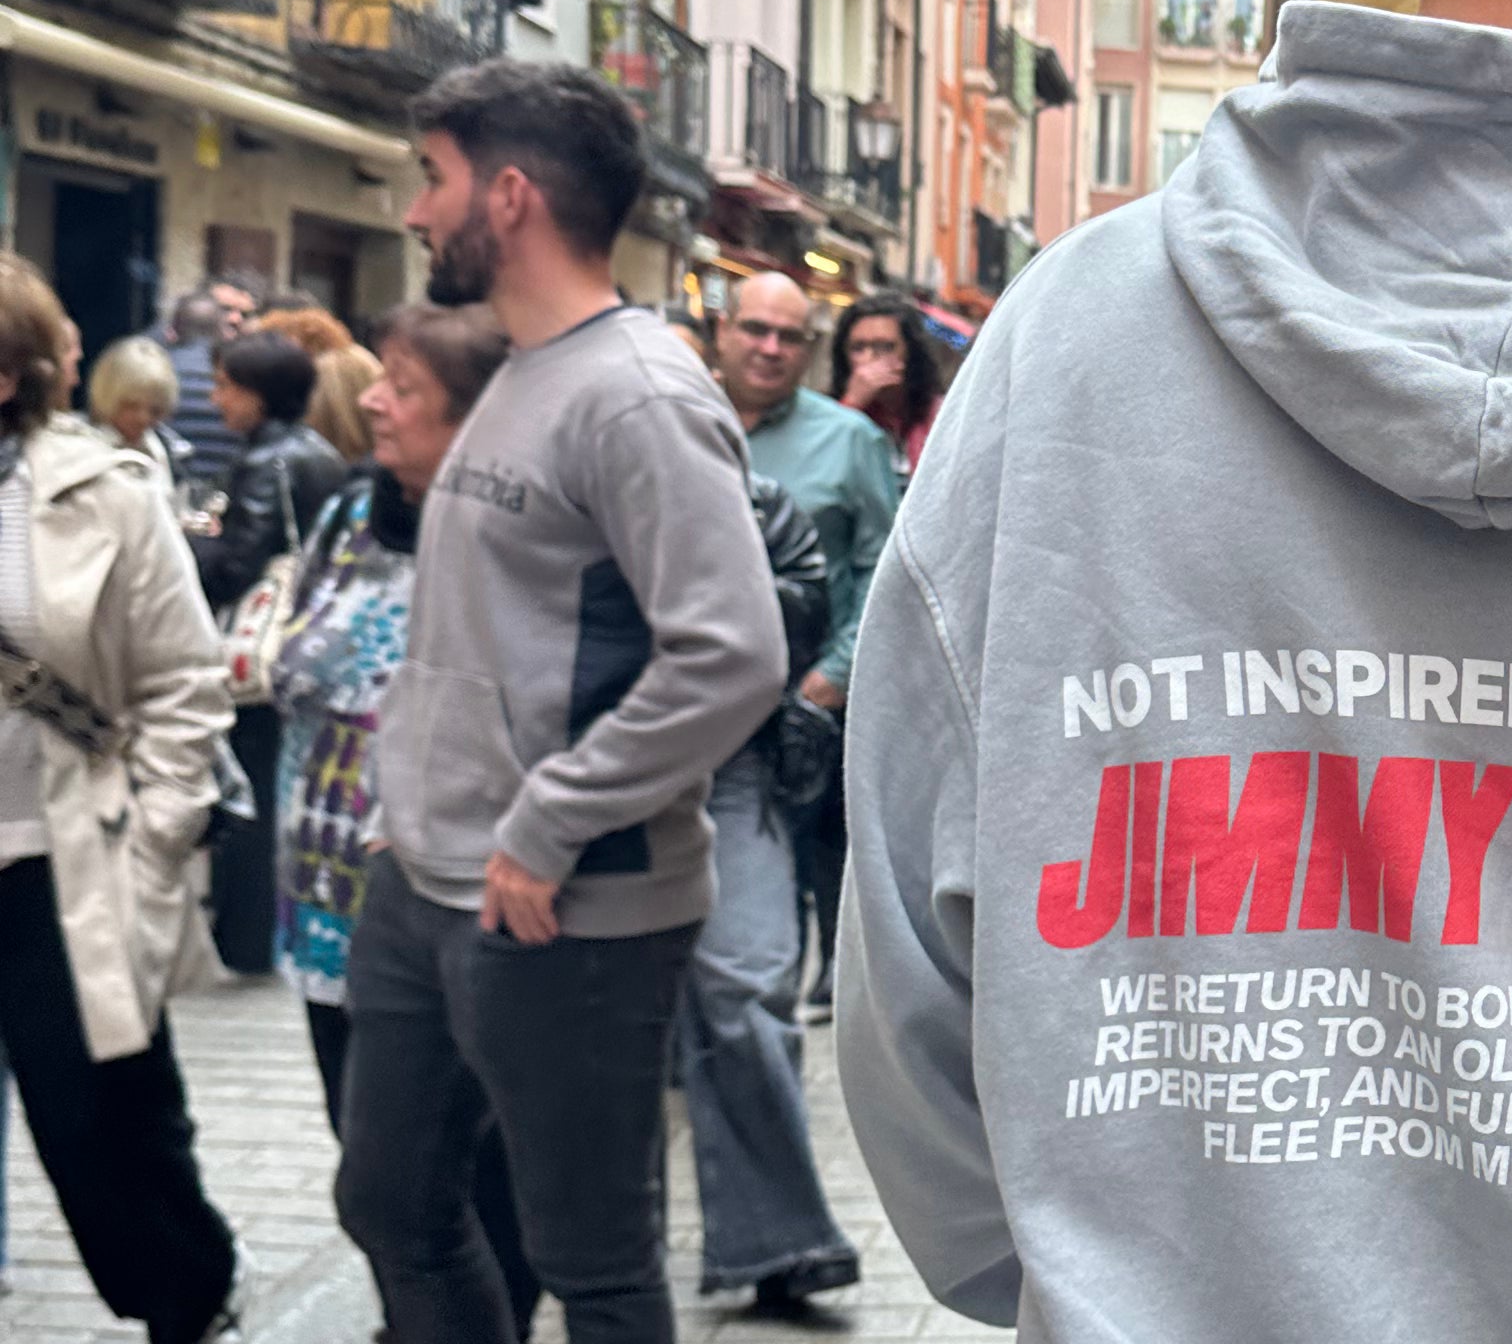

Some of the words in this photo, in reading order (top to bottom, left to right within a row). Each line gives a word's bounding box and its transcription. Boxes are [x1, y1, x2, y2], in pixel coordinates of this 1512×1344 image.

[1063, 655, 1203, 738] NOT
[1100, 973, 1168, 1016] WE
[1174, 967, 1371, 1014] RETURN
[1381, 971, 1426, 1020] TO
[1094, 1019, 1304, 1066] RETURNS
[1318, 1016, 1386, 1057] TO
[1393, 1024, 1441, 1074] AN
[1065, 1067, 1331, 1118] IMPERFECT,
[1341, 1066, 1440, 1113] AND
[1204, 1119, 1319, 1164] FLEE
[1330, 1115, 1464, 1171] FROM
